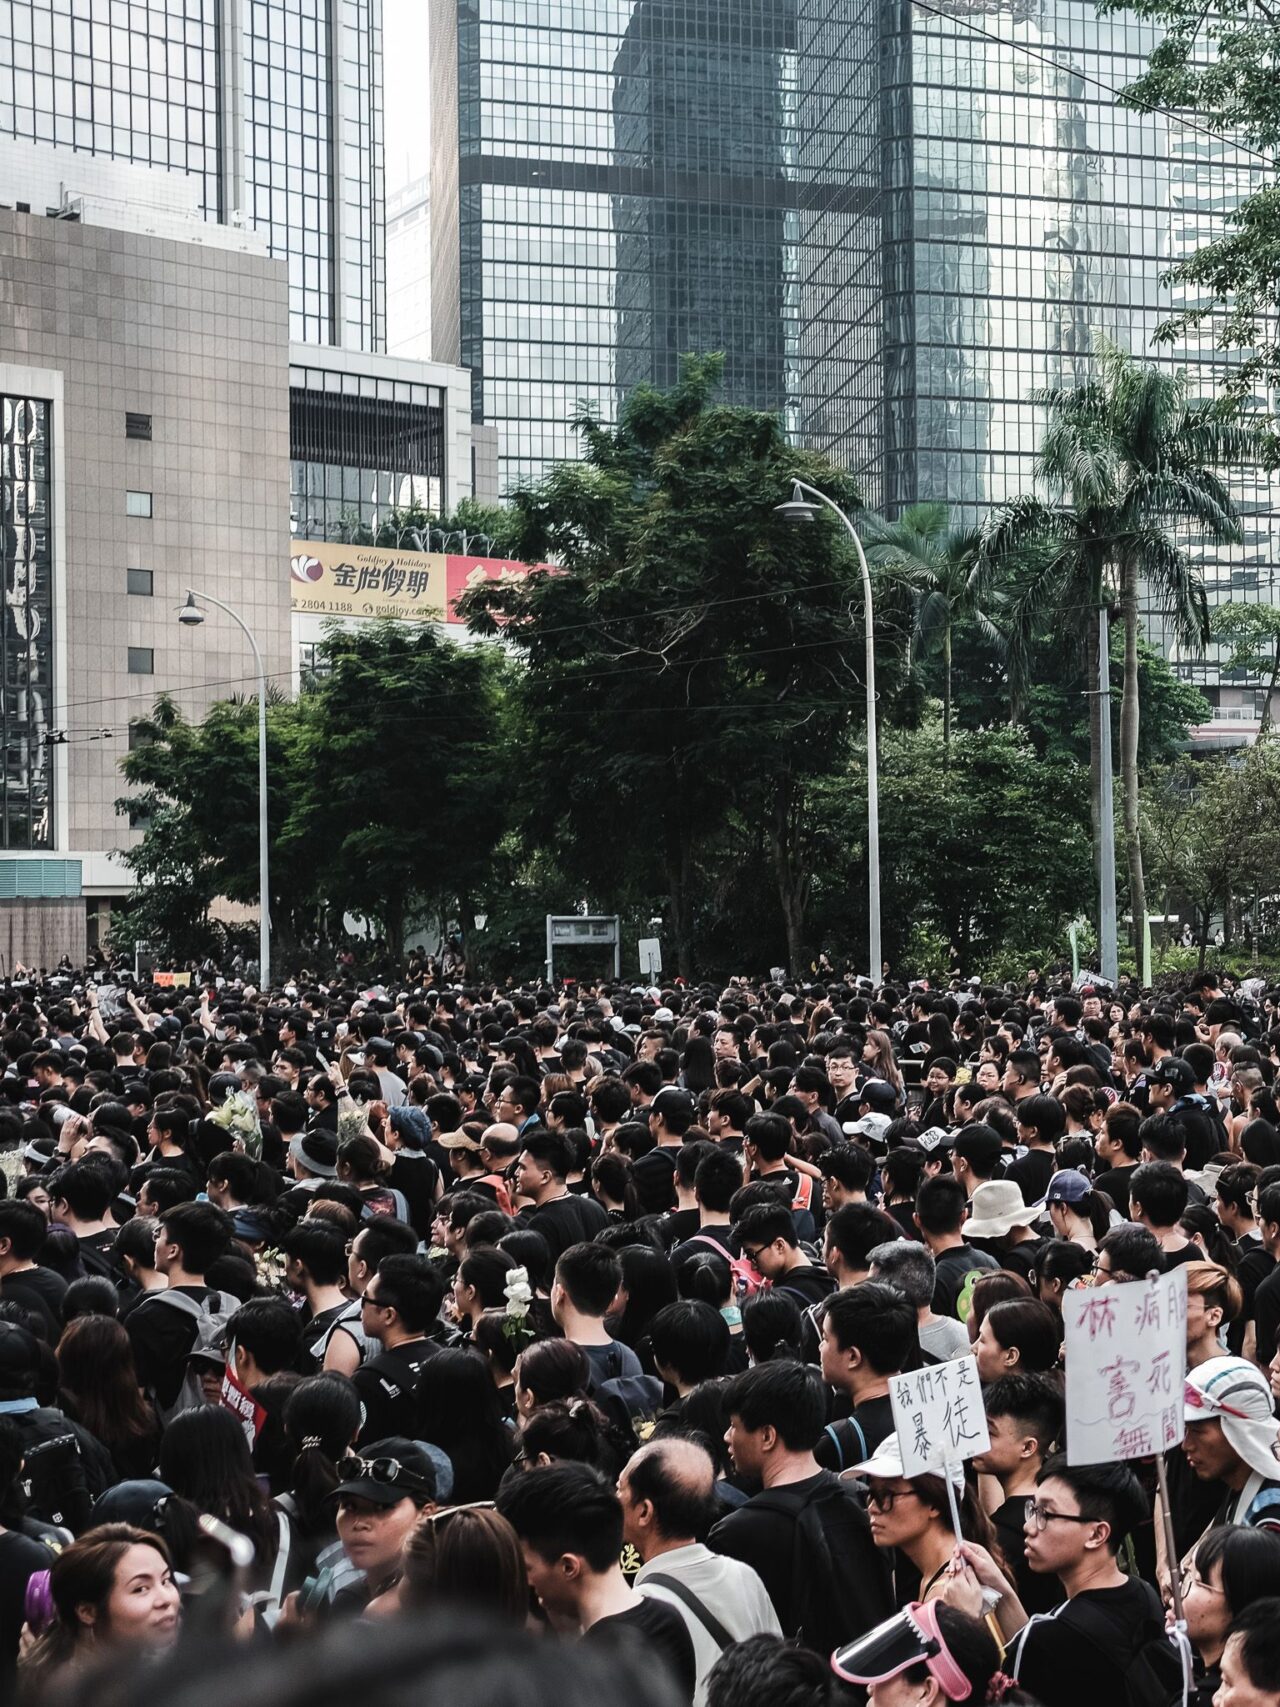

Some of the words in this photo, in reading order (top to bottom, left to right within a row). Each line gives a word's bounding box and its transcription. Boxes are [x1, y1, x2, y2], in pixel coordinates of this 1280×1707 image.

[329, 560, 429, 599] 金怡假期
[357, 554, 388, 566] Goldjoy
[396, 557, 431, 568] Holidays
[301, 599, 326, 610] 2804
[329, 601, 353, 612] 1188
[897, 1360, 975, 1409] 我們不是
[912, 1395, 981, 1461] 暴徒
